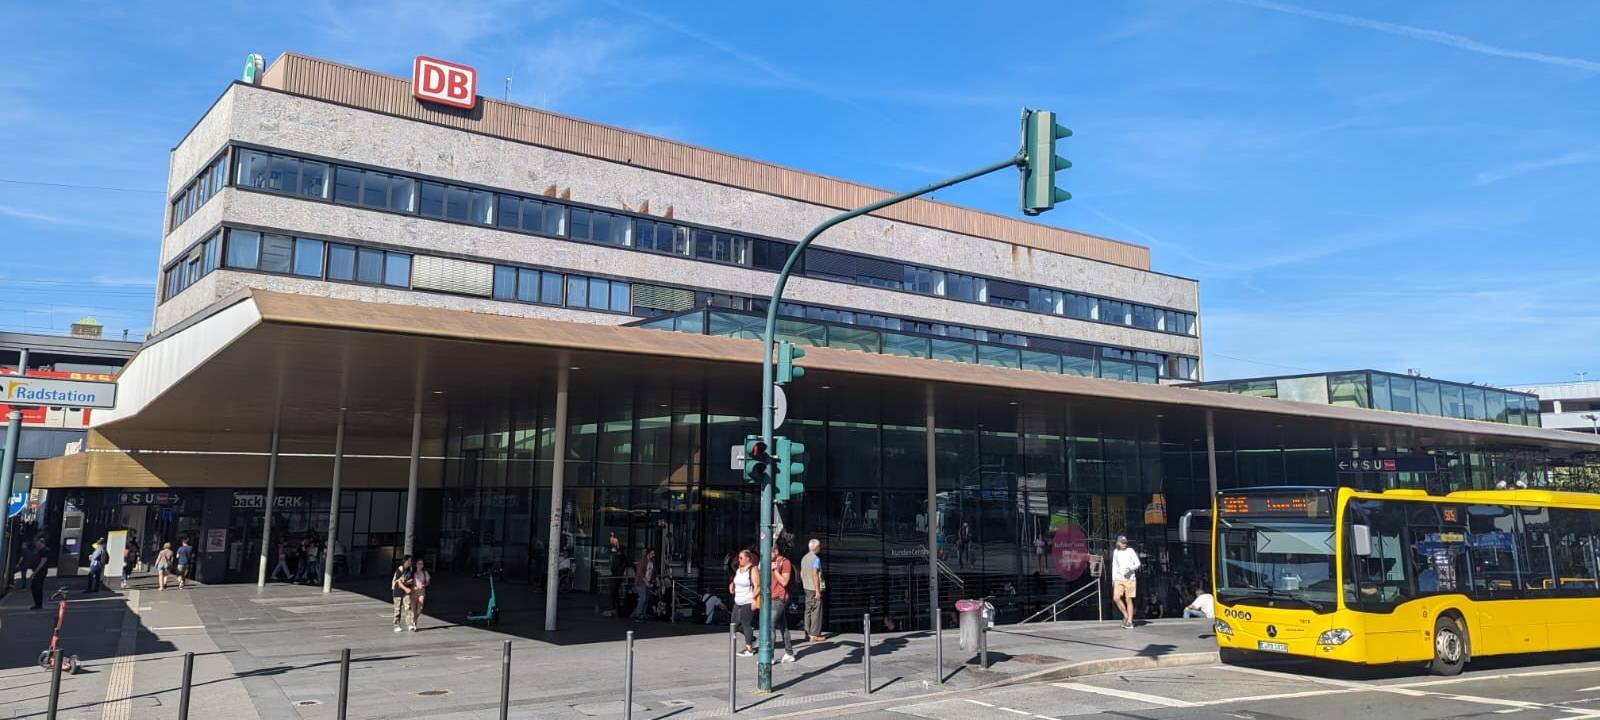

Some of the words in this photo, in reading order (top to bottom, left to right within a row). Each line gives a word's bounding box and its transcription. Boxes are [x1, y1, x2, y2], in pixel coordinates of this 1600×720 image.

[422, 63, 469, 100] DB
[16, 386, 96, 402] Radstation
[1362, 460, 1370, 470] S
[1374, 460, 1382, 470] U
[132, 494, 141, 504] S
[145, 494, 154, 504] U
